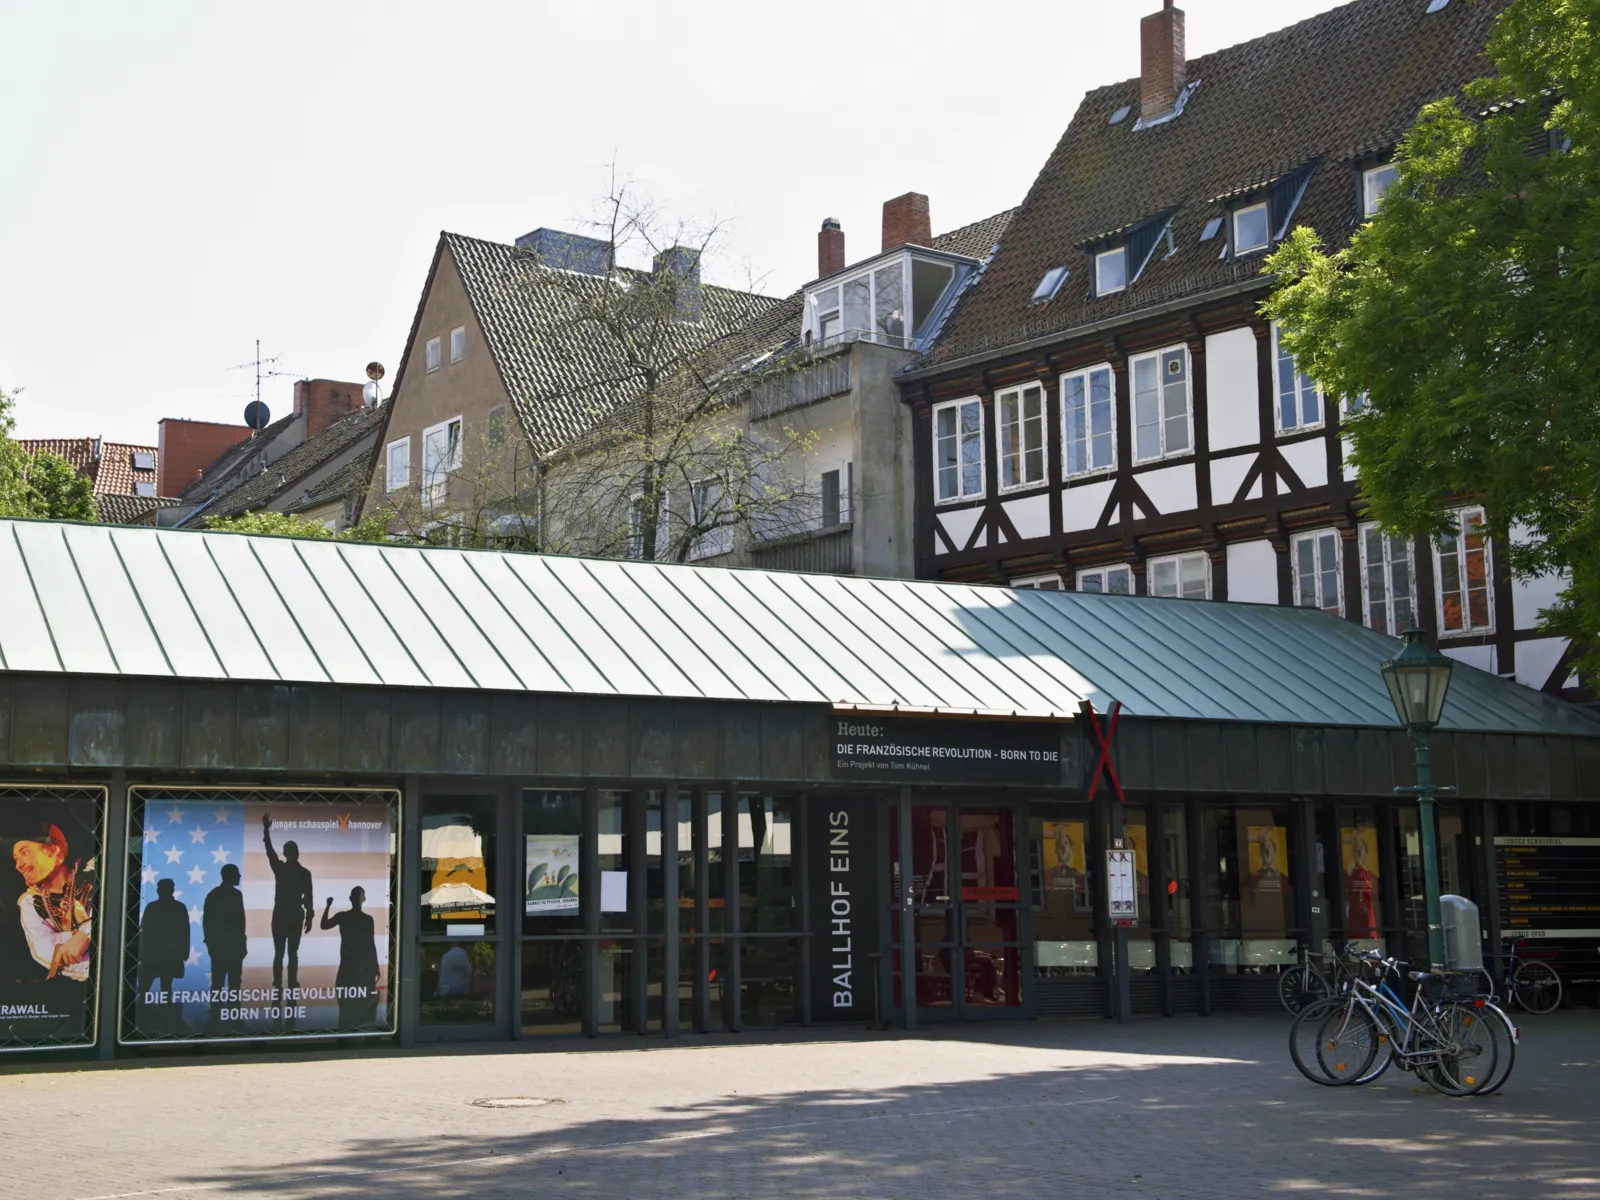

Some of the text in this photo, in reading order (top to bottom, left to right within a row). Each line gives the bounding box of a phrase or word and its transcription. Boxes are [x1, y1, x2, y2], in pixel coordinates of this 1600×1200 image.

[837, 721, 884, 737] Heute:
[837, 744, 854, 755] DIE
[856, 743, 931, 758] FRANZÖSISCHE
[932, 747, 992, 759] REVOLUTION
[1000, 749, 1027, 760] BORN
[1029, 750, 1041, 760] TO
[1043, 751, 1058, 761] DIE
[850, 761, 875, 769] Projekt
[890, 762, 905, 770] Tom
[906, 763, 931, 771] Kühnel
[271, 819, 297, 830] junges
[299, 820, 339, 831] schauspiel
[348, 820, 382, 830] hannover
[829, 810, 853, 1008] BALLHOF EINS
[144, 991, 168, 1005] DIE
[172, 987, 279, 1004] FRANZÖSISCHE
[282, 986, 367, 1001] REVOLUTION
[0, 1004, 48, 1015] RAWALL
[220, 1006, 307, 1021] BORN TO DIE
